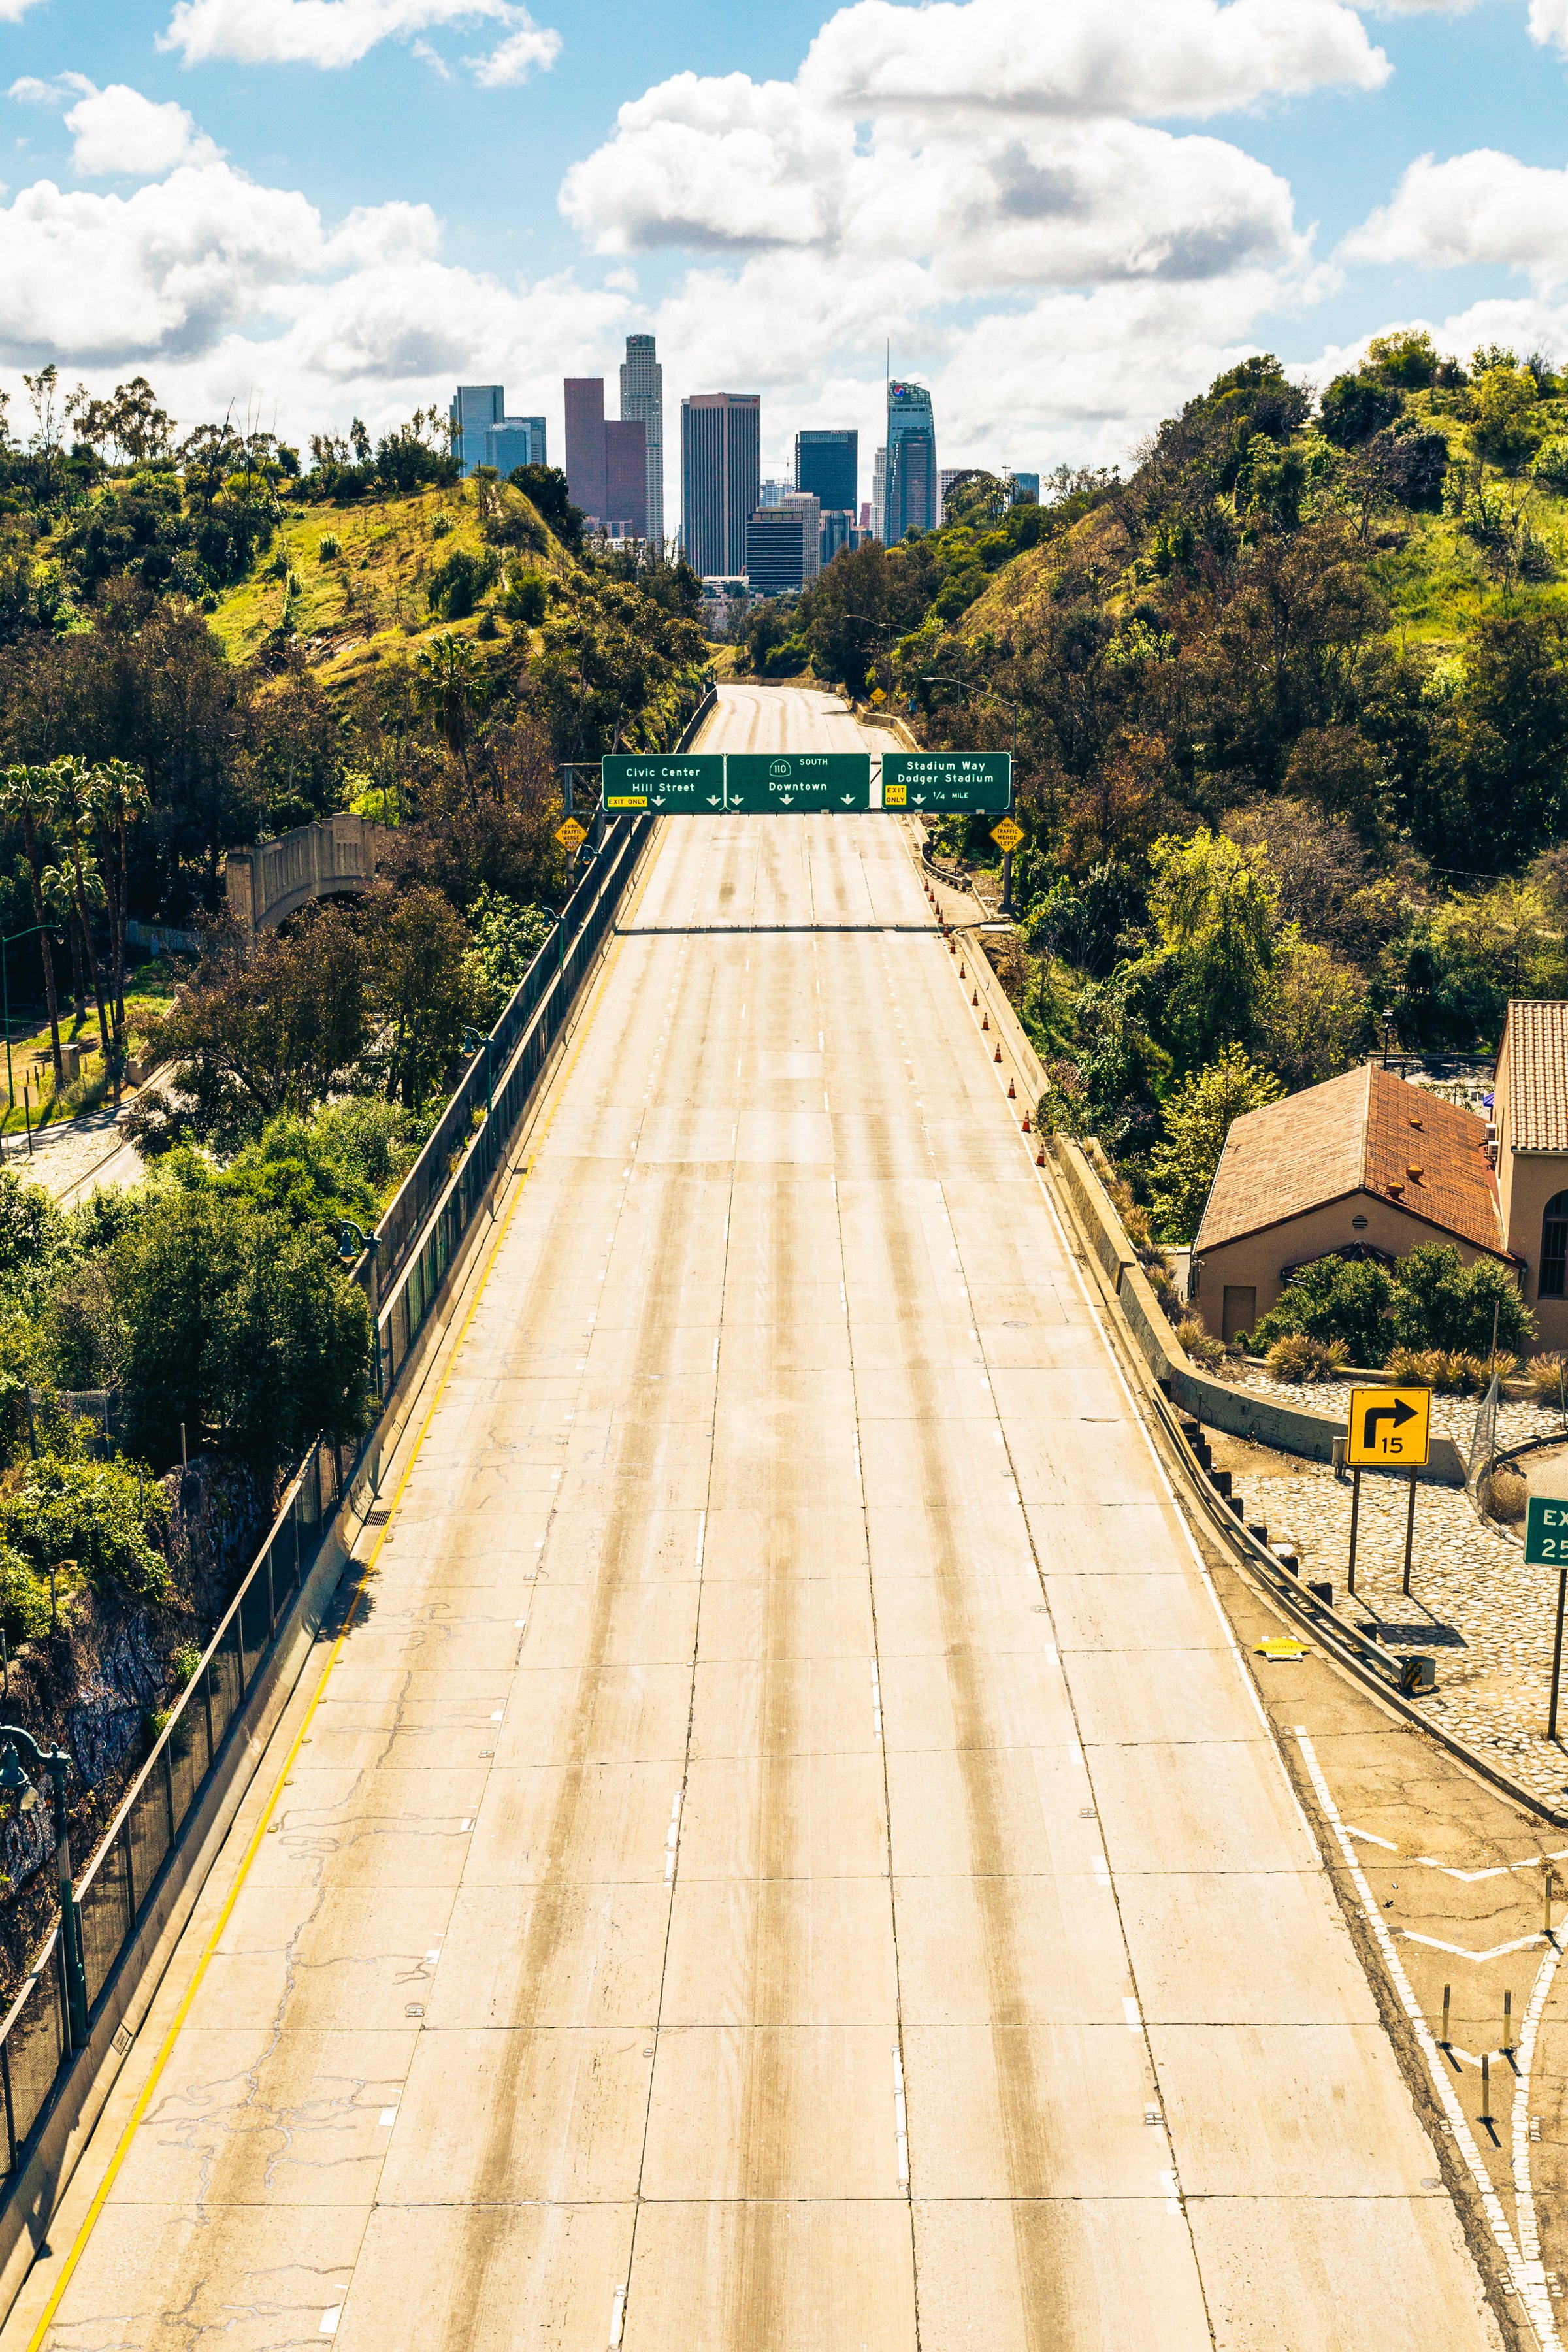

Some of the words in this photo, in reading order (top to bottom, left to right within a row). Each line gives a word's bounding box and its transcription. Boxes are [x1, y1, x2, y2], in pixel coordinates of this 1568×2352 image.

[907, 761, 955, 770] Stadium
[962, 761, 985, 772] Way
[626, 768, 655, 777] Civic
[661, 768, 700, 777] Center
[898, 774, 938, 785] Dodger
[945, 774, 994, 783] Stadium
[632, 783, 653, 792] Hill
[659, 783, 694, 792] Street
[769, 782, 826, 791] Downtown
[1382, 1437, 1403, 1454] 15
